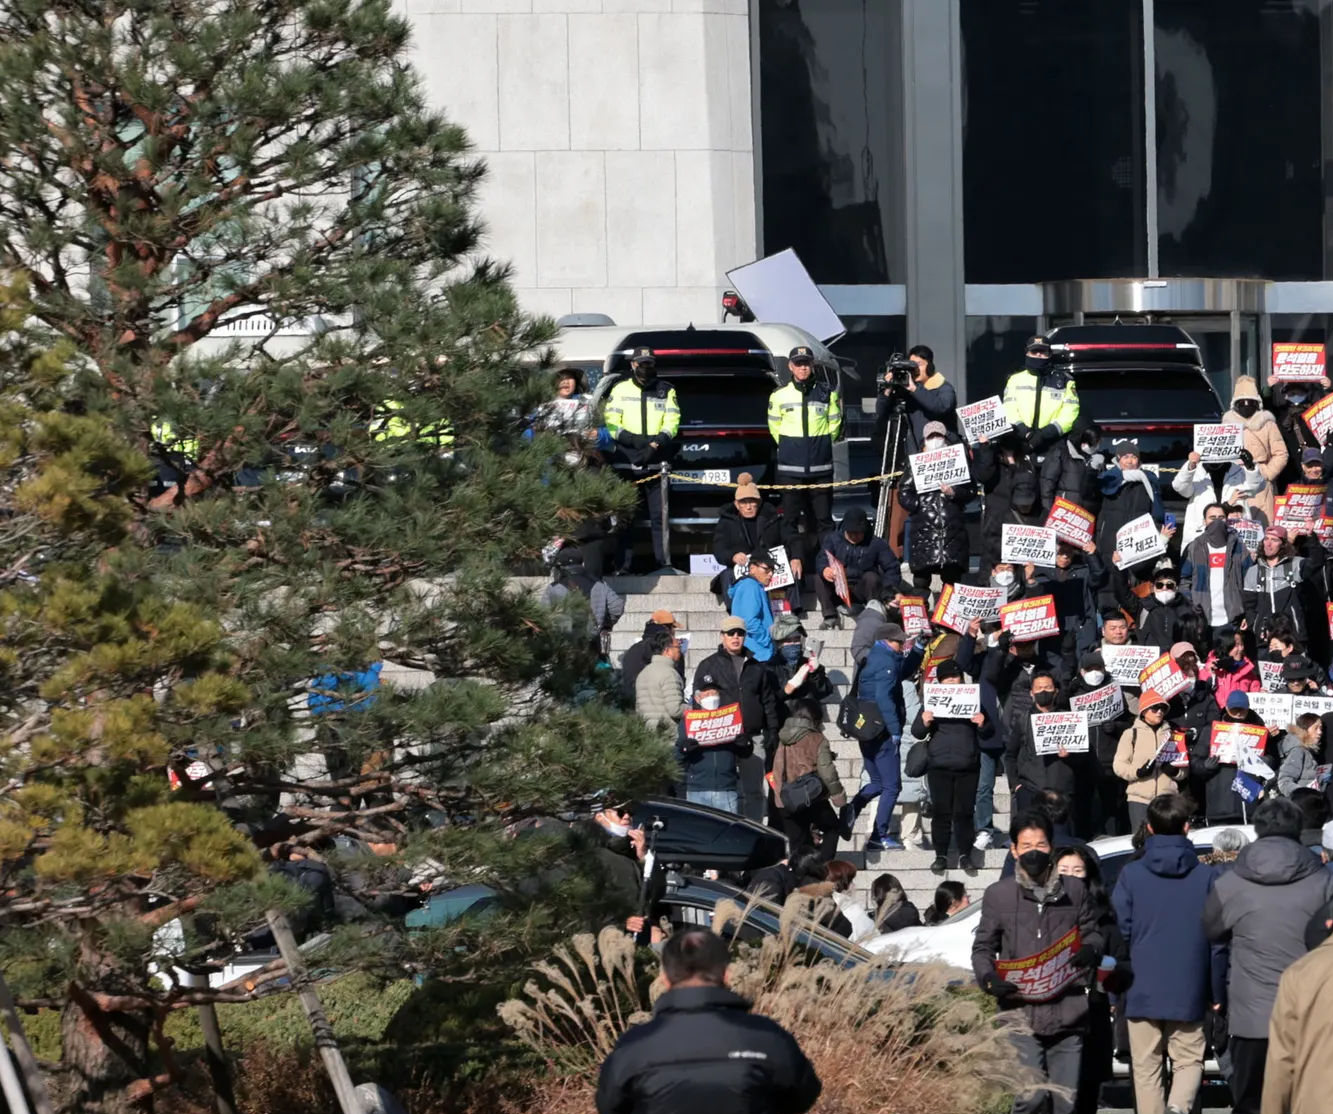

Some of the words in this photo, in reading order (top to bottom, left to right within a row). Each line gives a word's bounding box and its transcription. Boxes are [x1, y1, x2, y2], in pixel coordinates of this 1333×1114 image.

[1276, 352, 1318, 364] 윤석열을
[1279, 364, 1324, 376] 타도하자!
[960, 398, 998, 419] 친일매국노
[963, 409, 995, 428] 윤석열을
[971, 416, 1007, 436] 탄핵하자!
[1197, 426, 1240, 435] 친일매국노
[1197, 436, 1236, 446] 윤석열을
[914, 450, 960, 465] 친일매국노
[917, 459, 956, 475] 윤석열을
[703, 472, 728, 482] 1983
[924, 467, 967, 485] 탄핵하자!
[1006, 526, 1052, 539] 친일매국노
[1238, 530, 1258, 540] 석열을
[1006, 536, 1046, 549] 윤석열을
[1135, 536, 1158, 553] 체포!
[1010, 547, 1054, 559] 탄핵하자!
[958, 587, 1003, 598] 친일매국노
[958, 596, 997, 608] 윤석열을
[1004, 608, 1047, 625] 윤석열을
[1116, 647, 1155, 658] 일매국노
[1155, 670, 1184, 696] 도하자!
[1074, 684, 1117, 706] 친일매국노
[927, 696, 952, 707] 즉각
[949, 704, 978, 715] 체포!
[689, 714, 733, 732] 윤석열을
[1035, 714, 1083, 725] 친일매국노
[694, 725, 742, 742] 타도하자!
[1036, 724, 1077, 736] 윤석열을
[1043, 735, 1086, 747] 탄핵하자!
